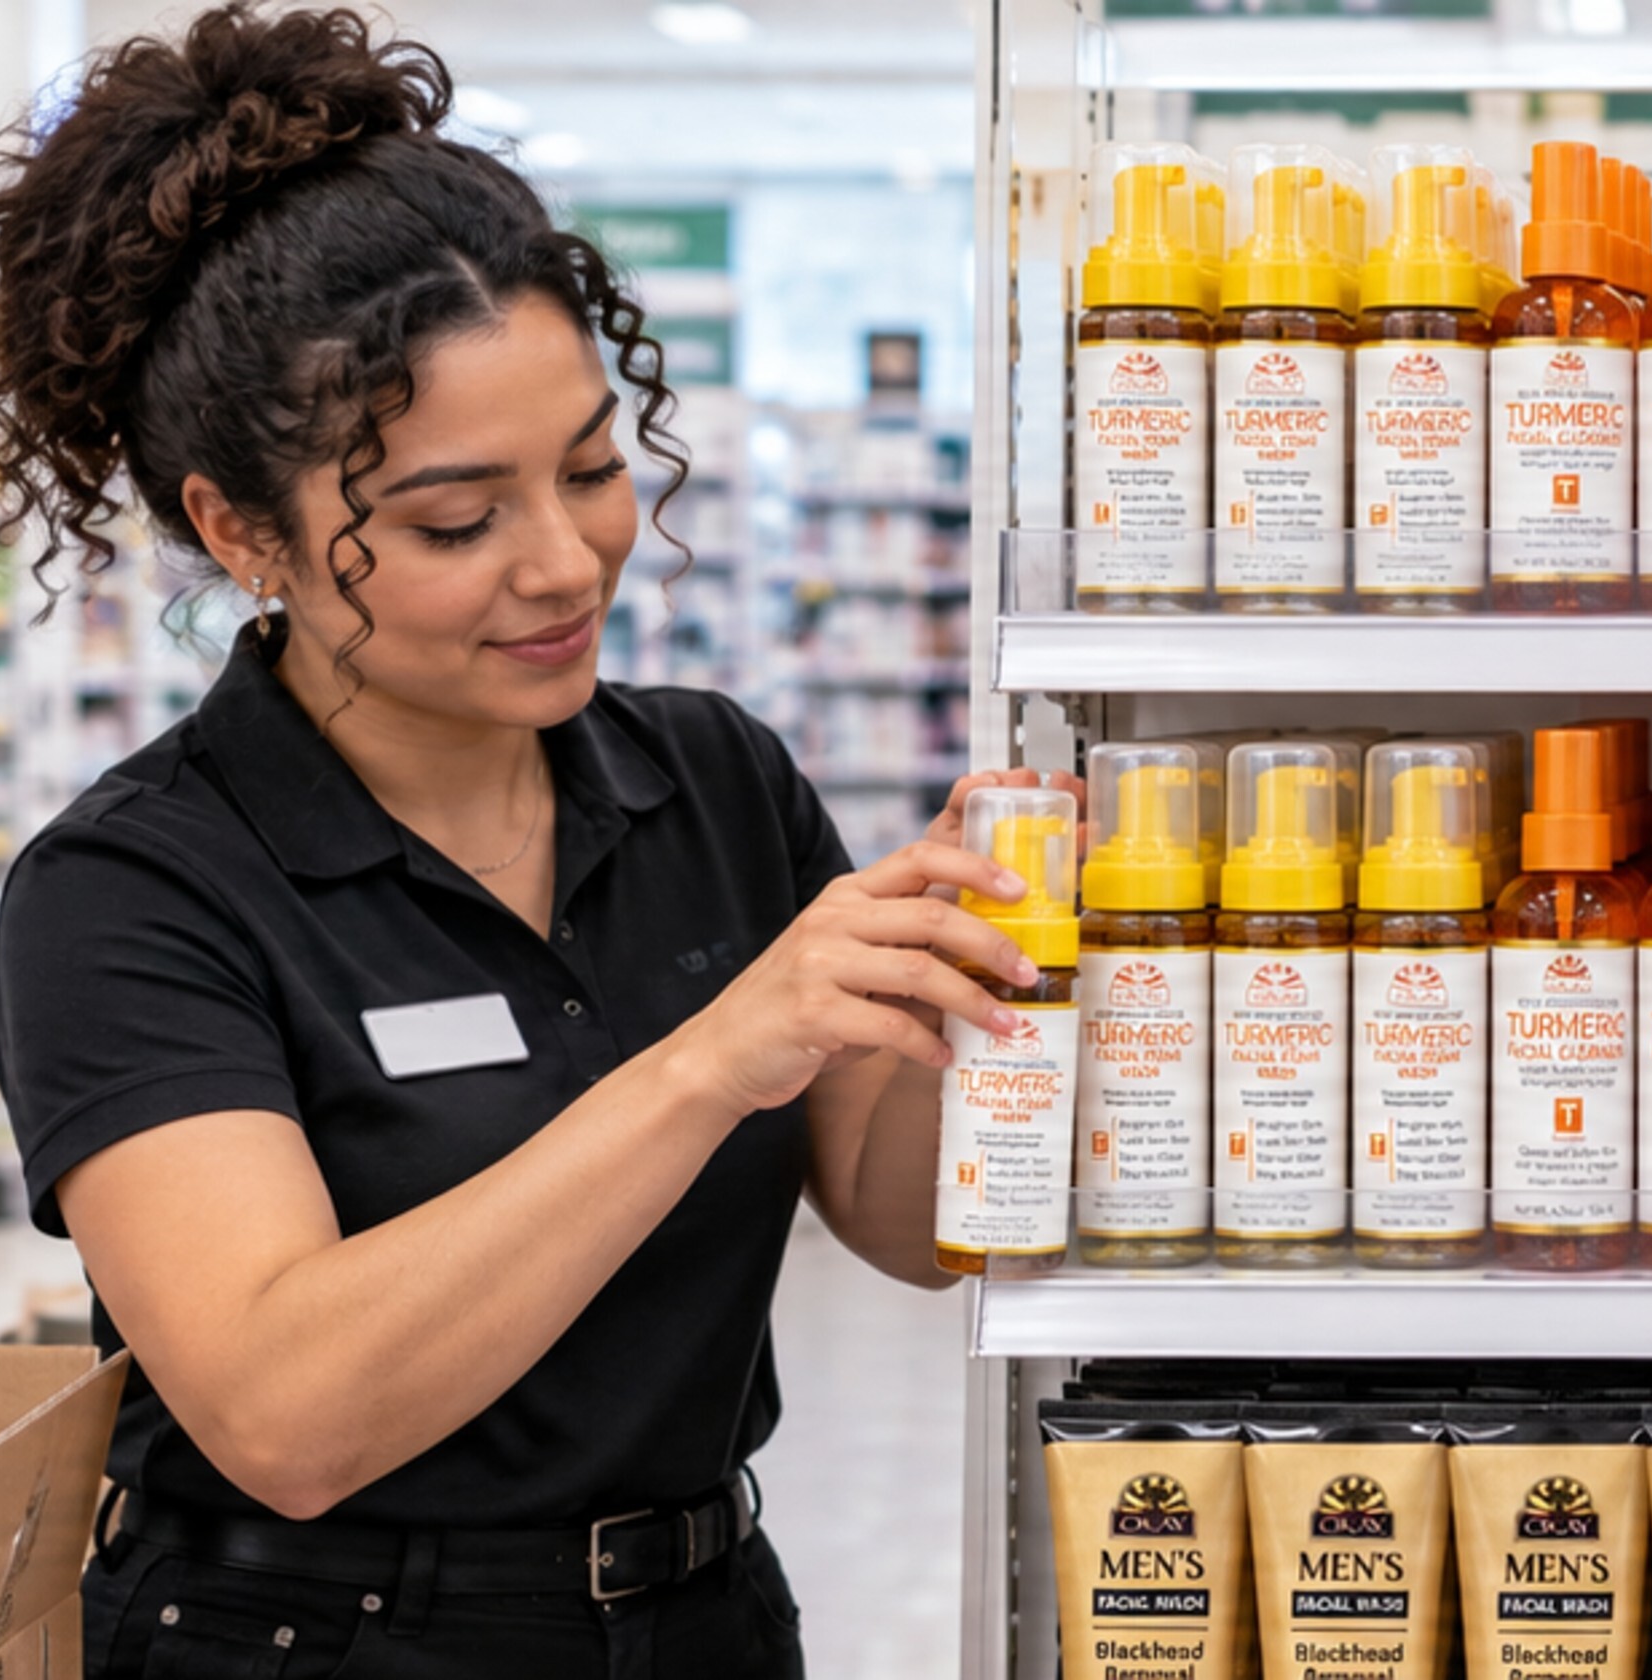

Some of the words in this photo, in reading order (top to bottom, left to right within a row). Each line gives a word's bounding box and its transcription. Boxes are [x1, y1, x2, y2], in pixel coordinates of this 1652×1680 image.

[1558, 480, 1574, 500] T
[1562, 1104, 1576, 1127] T
[1100, 1550, 1205, 1579] MEN'S
[1298, 1552, 1404, 1582] MEN'S
[1505, 1553, 1610, 1584] MEN'S
[1096, 1641, 1204, 1660] Blackhead
